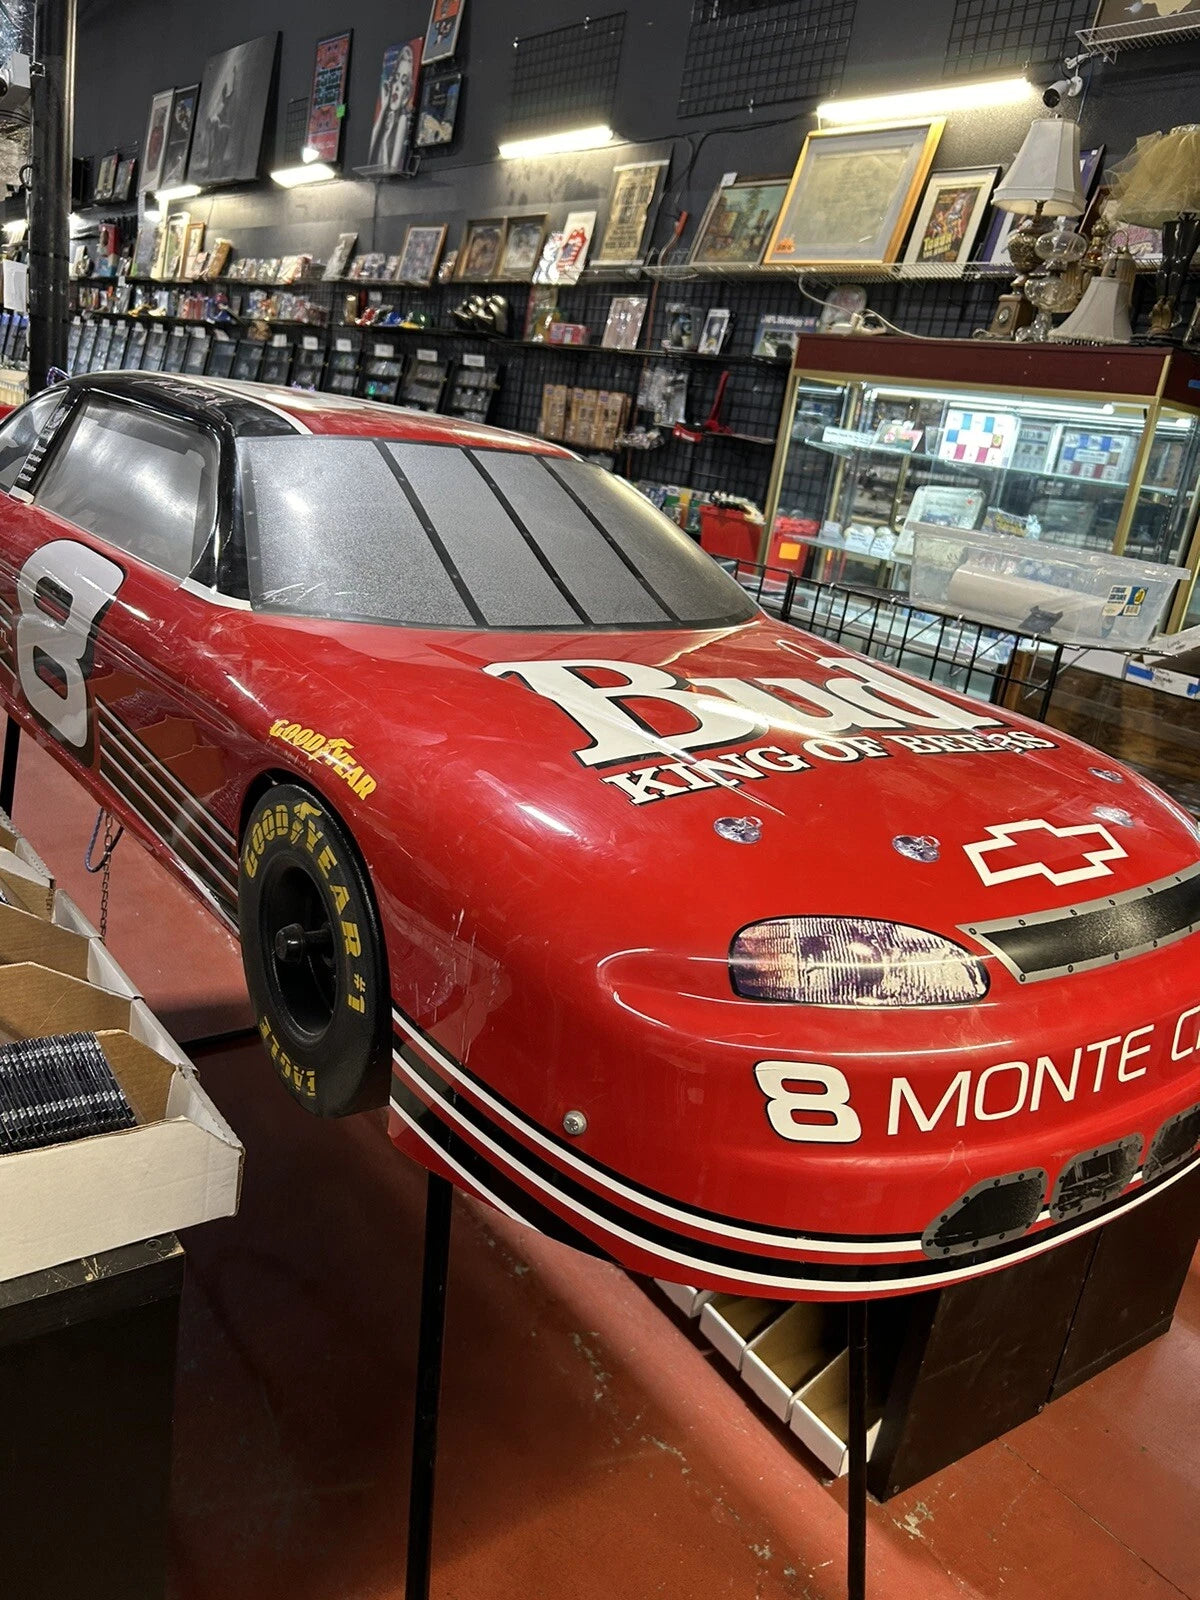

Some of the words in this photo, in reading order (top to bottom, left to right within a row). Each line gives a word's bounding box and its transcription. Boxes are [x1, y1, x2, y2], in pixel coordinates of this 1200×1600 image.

[16, 538, 125, 750] 8
[480, 642, 1010, 768] Bud
[269, 719, 378, 802] GOODYEAR
[601, 744, 816, 807] KING
[801, 735, 896, 765] OF
[886, 729, 1060, 758] BEERS
[243, 800, 363, 958] GOODYEAR
[347, 973, 369, 1015] #1
[260, 1016, 317, 1098] EAGLE
[753, 1060, 862, 1145] 8
[886, 1024, 1156, 1137] MONTE
[1170, 1004, 1200, 1063] C
